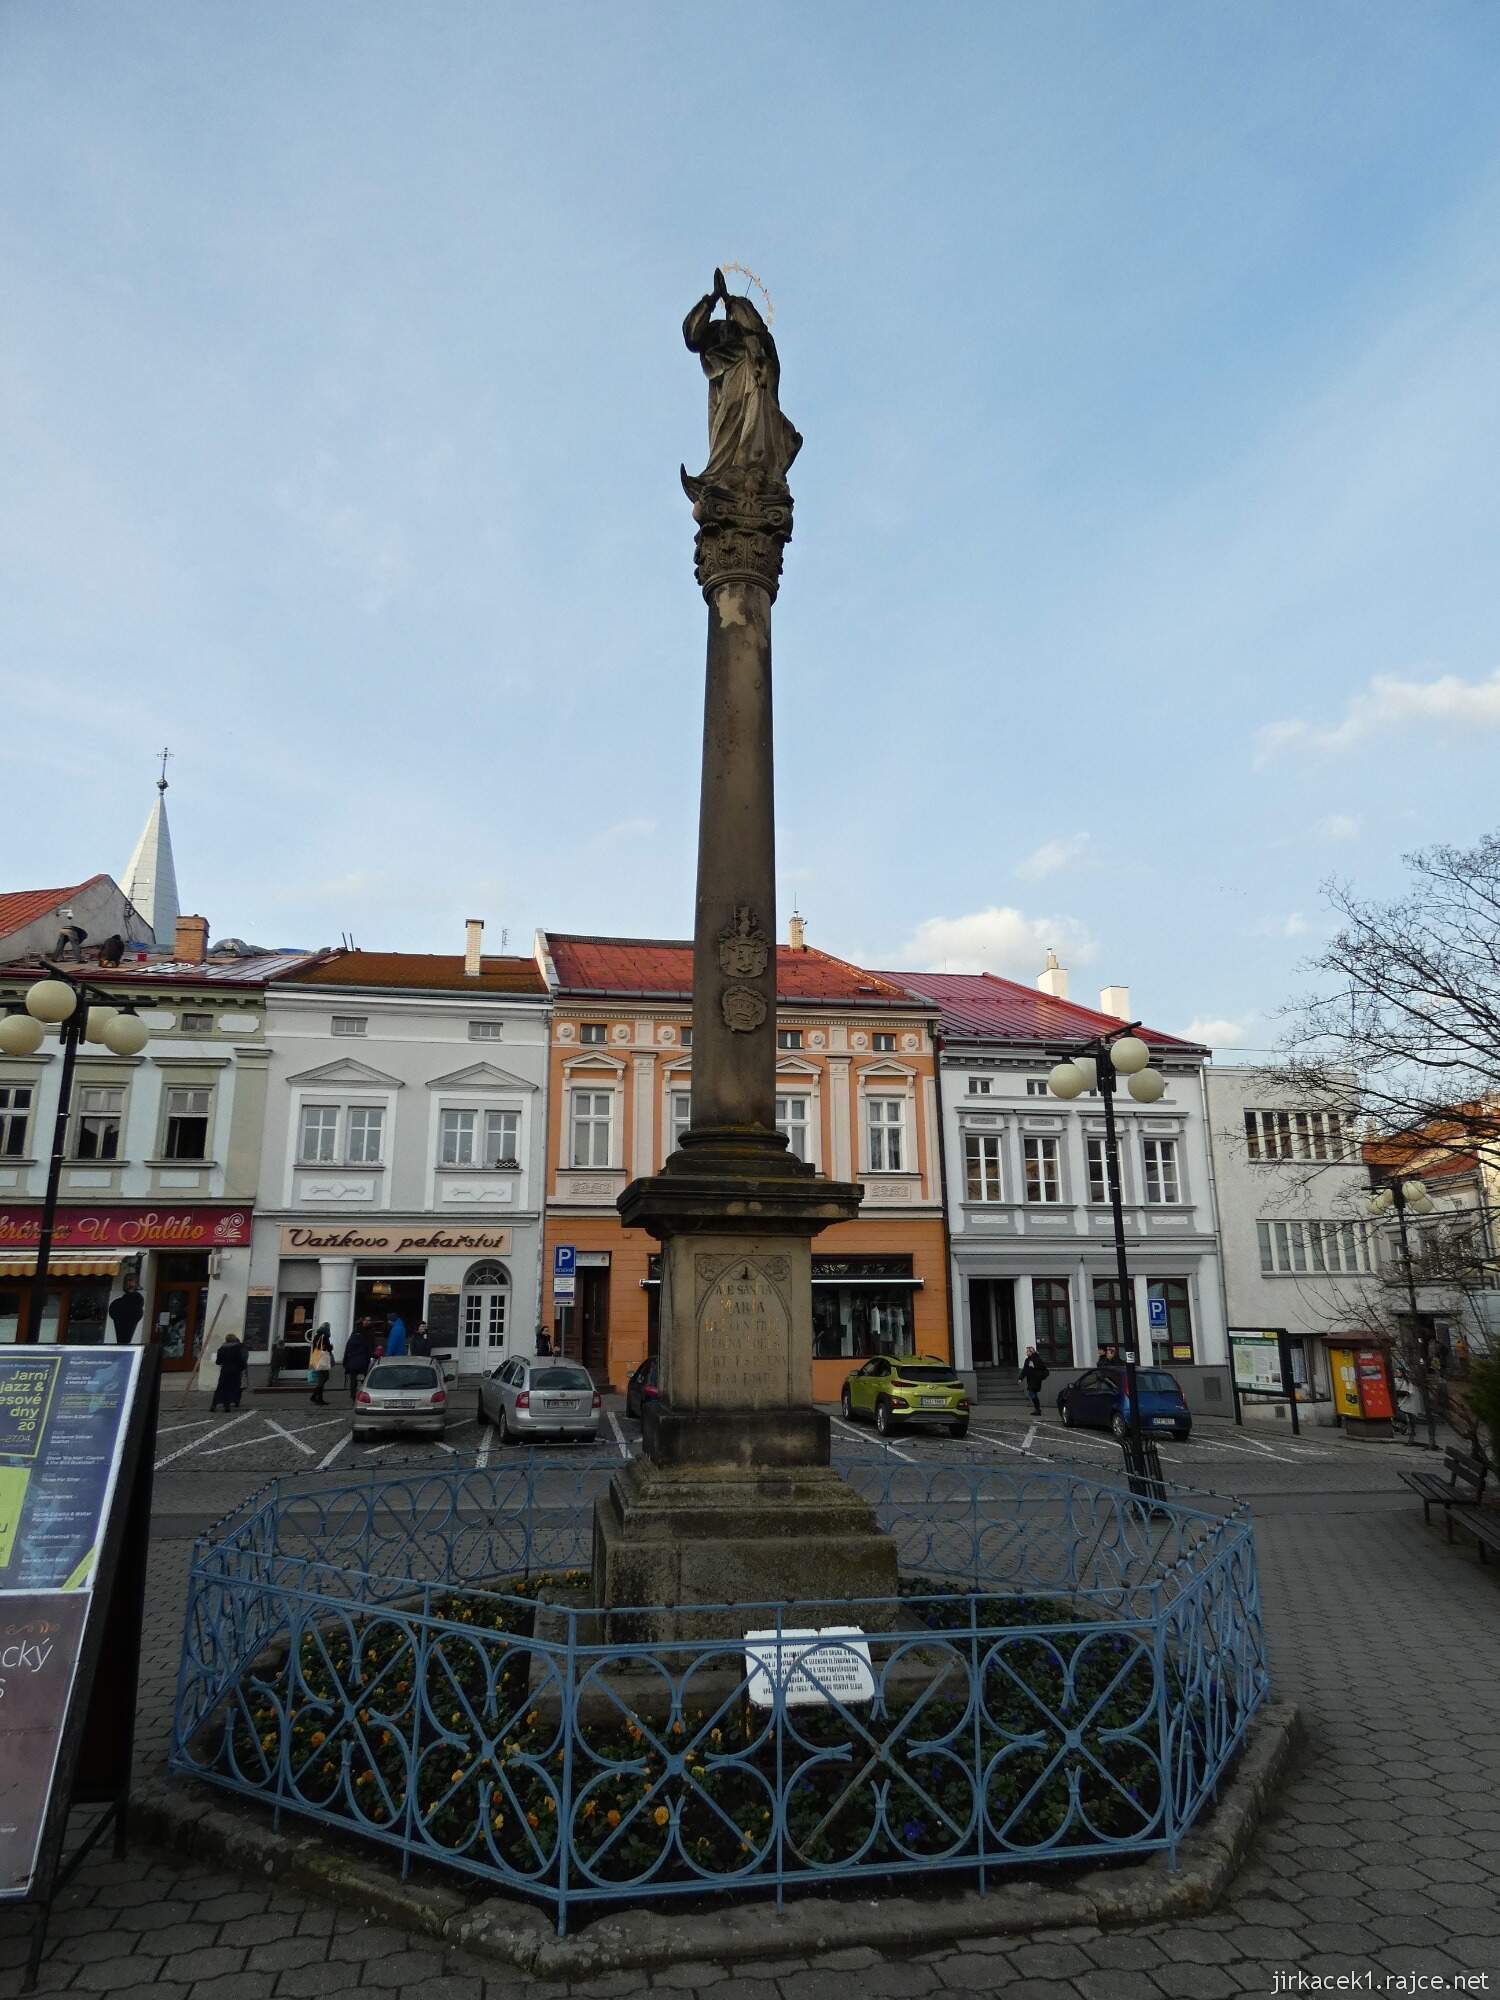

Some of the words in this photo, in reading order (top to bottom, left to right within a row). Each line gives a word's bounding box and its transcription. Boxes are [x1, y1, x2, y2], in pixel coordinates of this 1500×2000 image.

[78, 1217, 110, 1241] U
[119, 1212, 206, 1243] Saliho
[288, 1228, 389, 1247] Vaňkovo
[394, 1229, 504, 1253] pekařství
[558, 1248, 571, 1267] P
[1151, 1302, 1162, 1318] P
[11, 1369, 49, 1381] Jarní
[34, 1381, 44, 1392] &
[0, 1393, 42, 1405] esové
[10, 1406, 39, 1419] dny
[17, 1421, 36, 1431] 20
[0, 1637, 54, 1673] cký
